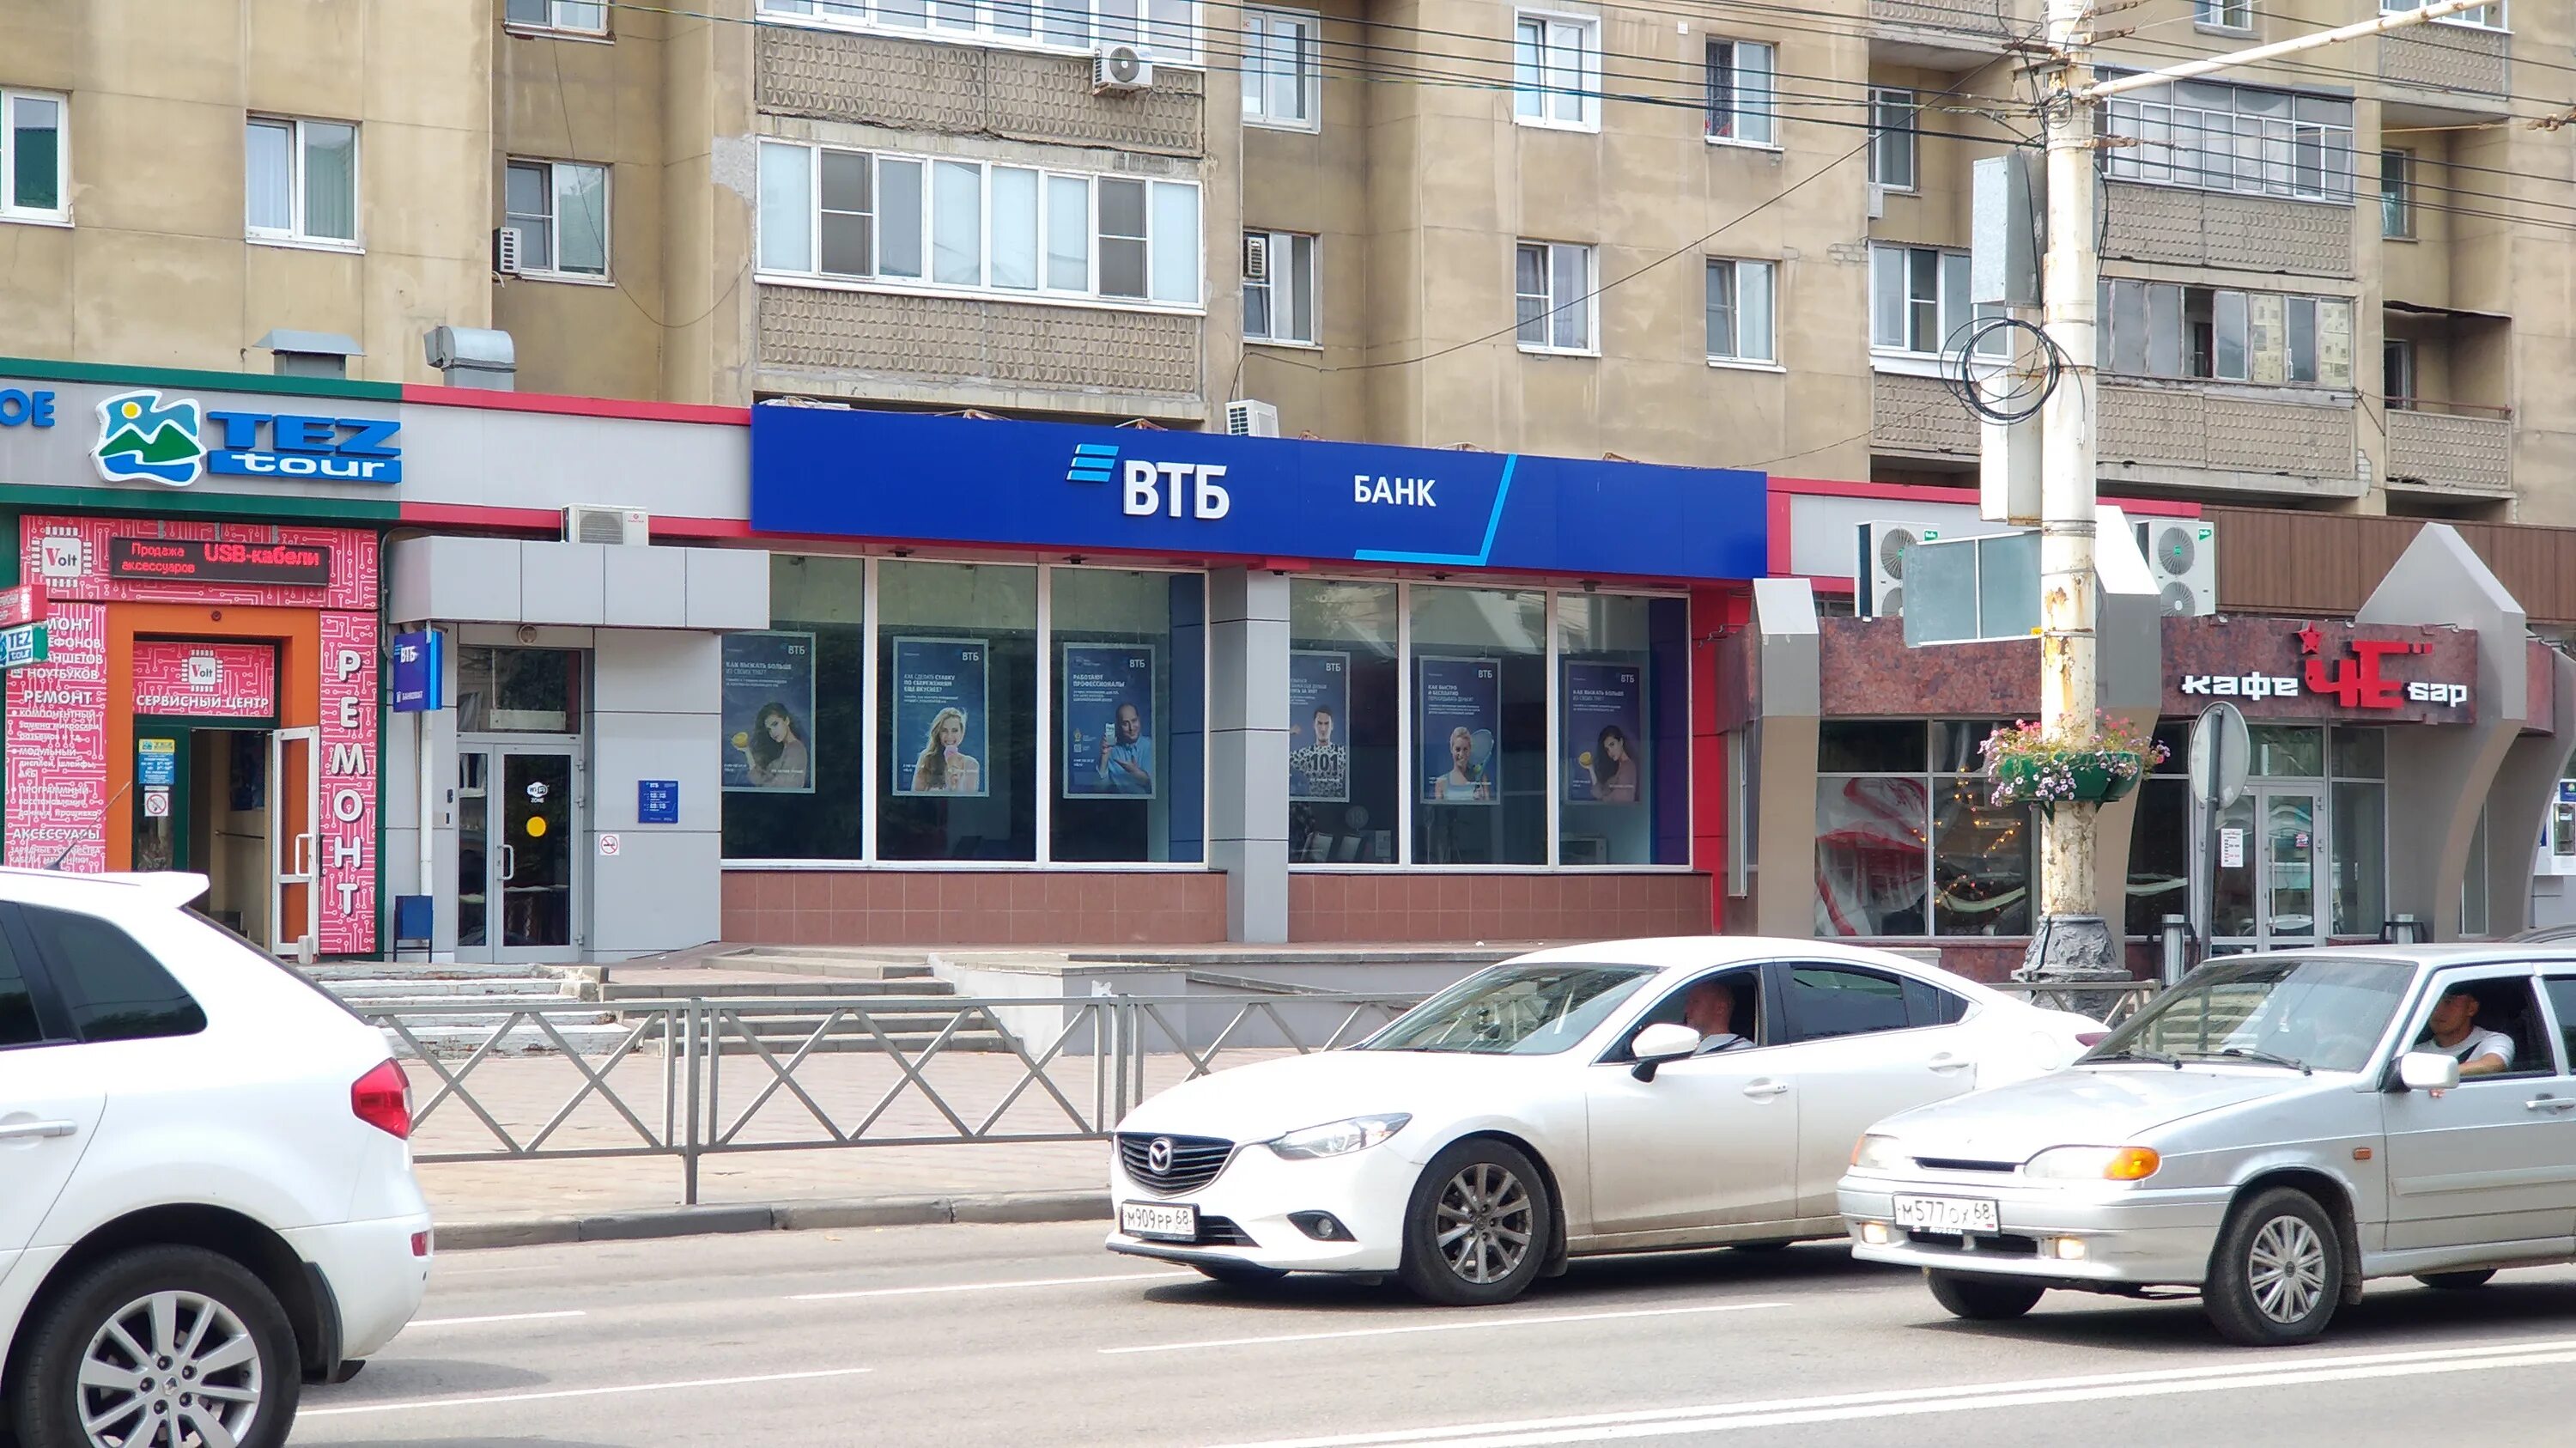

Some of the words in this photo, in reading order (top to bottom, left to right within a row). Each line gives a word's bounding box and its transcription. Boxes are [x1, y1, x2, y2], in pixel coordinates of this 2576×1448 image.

[206, 411, 402, 456] TEZ
[231, 453, 385, 478] tour
[1123, 459, 1230, 520] ВТБ
[1354, 474, 1436, 507] БАНК
[131, 542, 185, 557] Продажа
[204, 543, 319, 567] USB-кабели
[46, 547, 77, 568] Volt
[121, 560, 195, 575] аксессуаров
[47, 618, 92, 632] МОНТ
[9, 630, 31, 648] TEZ
[48, 637, 101, 648] ЕФОНОВ
[400, 645, 418, 663] ВТБ
[787, 645, 805, 654] ВТБ
[962, 652, 979, 661] ВТБ
[48, 653, 103, 665] АНШЕТОВ
[1129, 659, 1146, 668] ВТБ
[27, 667, 99, 680] НОУТБУКОВ
[191, 663, 213, 678] Volt
[1326, 662, 1341, 672] ВТБ
[1478, 669, 1493, 678] ВТБ
[2182, 672, 2299, 701] кафе
[24, 690, 92, 704] РЕМОНТ
[137, 693, 222, 709] СЕРВИСНЫЙ
[225, 697, 269, 710] ЦЕНТР
[331, 650, 368, 916] РЕМОНТ
[13, 828, 100, 841] АКСЕССУАРЫ
[1127, 1208, 1172, 1229] М909РР
[1176, 1209, 1188, 1226] 68
[1974, 1203, 1990, 1220] 68
